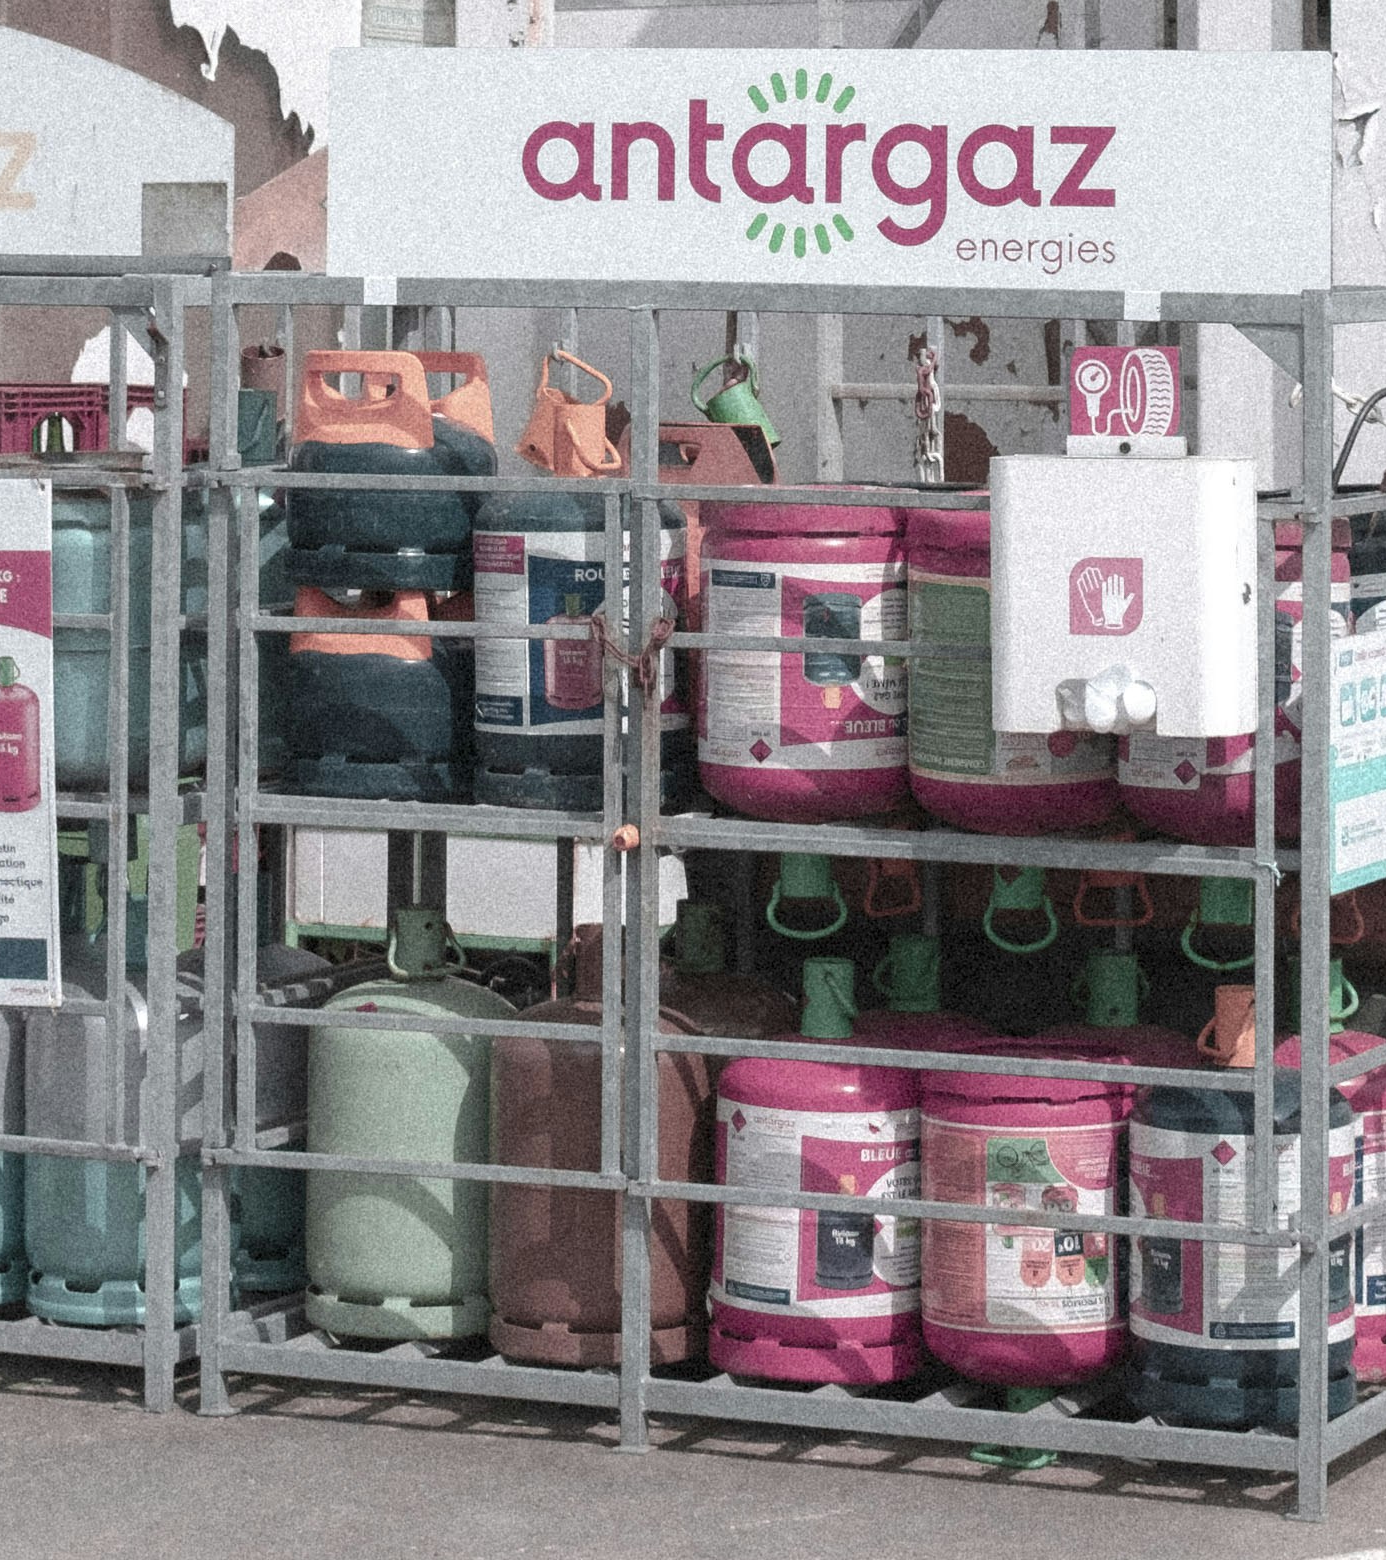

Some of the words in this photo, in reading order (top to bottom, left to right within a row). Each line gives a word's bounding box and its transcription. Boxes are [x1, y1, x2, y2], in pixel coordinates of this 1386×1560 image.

[522, 98, 1116, 247] antargaz
[955, 232, 1116, 275] energies
[861, 1148, 902, 1162] BLEUE
